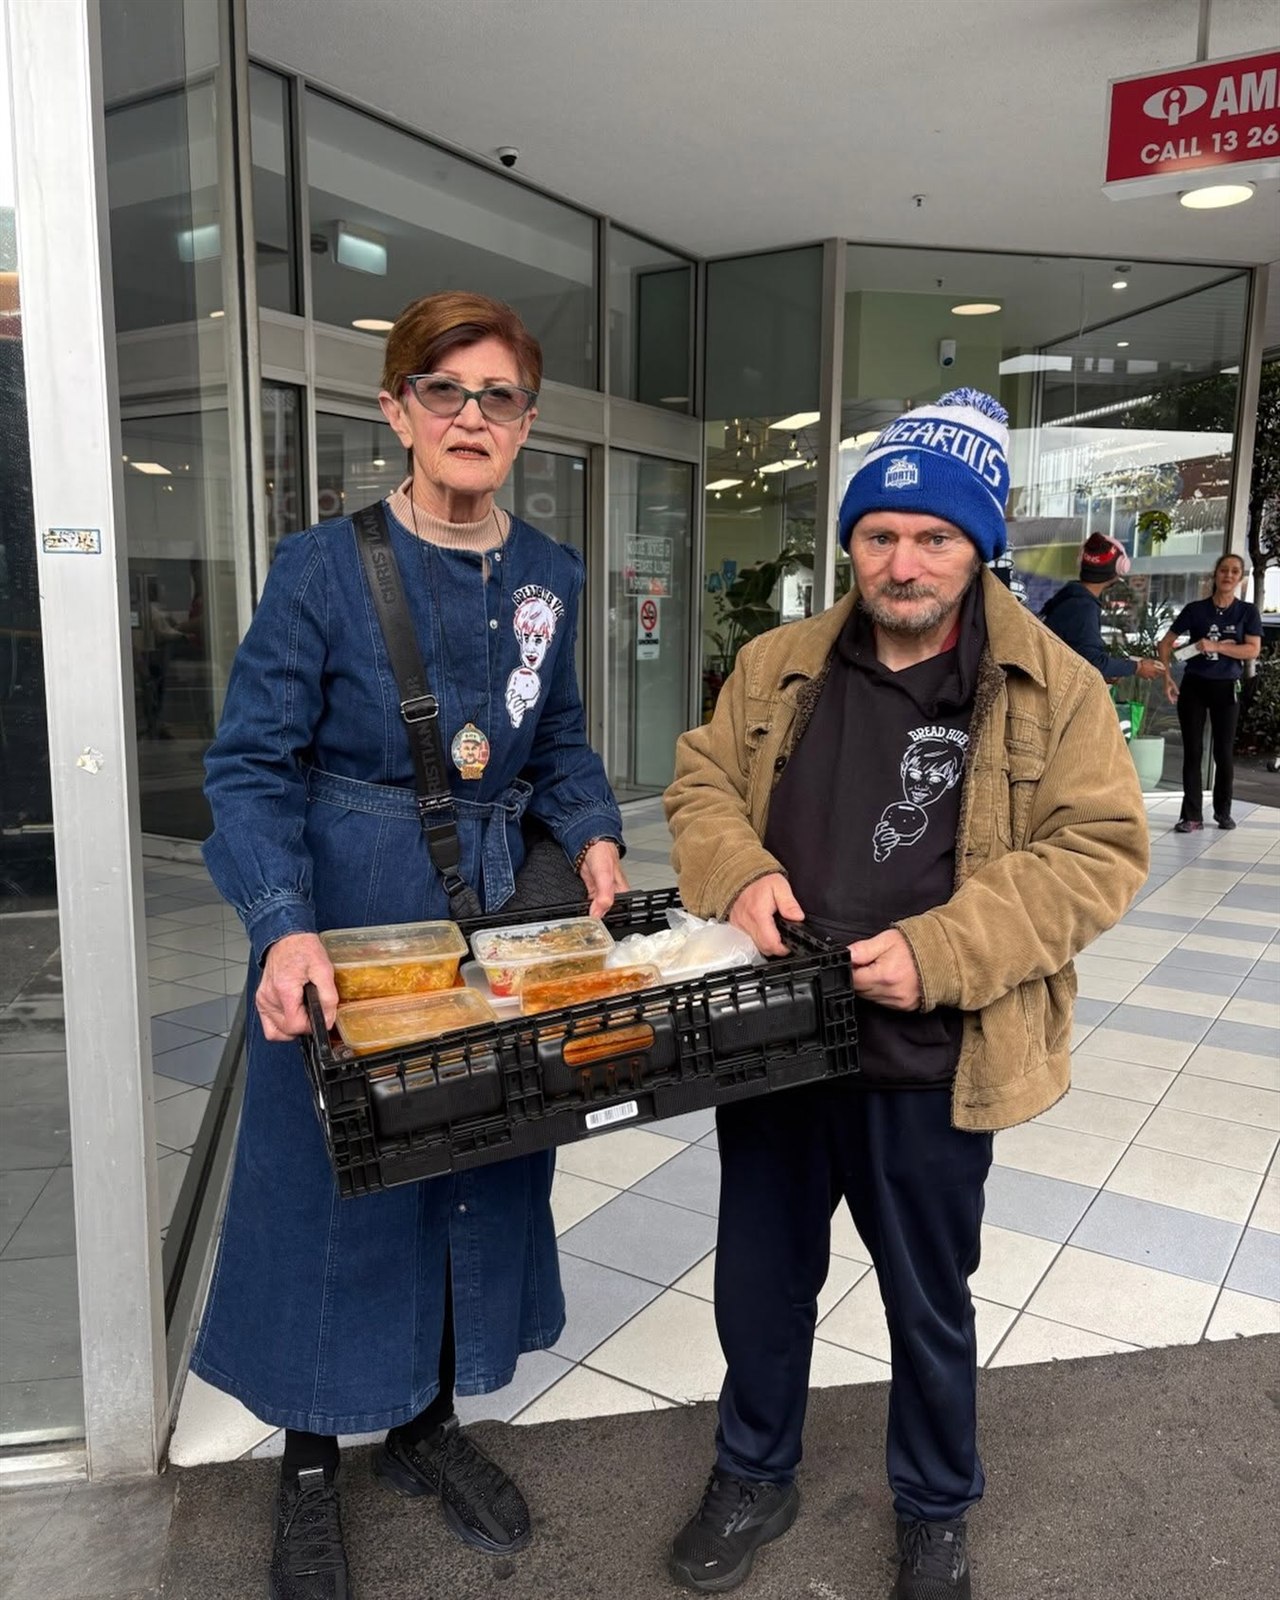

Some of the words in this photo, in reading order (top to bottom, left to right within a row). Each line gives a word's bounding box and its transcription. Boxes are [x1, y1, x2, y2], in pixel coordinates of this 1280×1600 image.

[1210, 68, 1280, 119] AM
[1140, 137, 1202, 164] CALL
[1211, 130, 1238, 153] 13
[1246, 124, 1279, 149] 26
[872, 421, 1006, 487] NGAROOS
[886, 470, 917, 483] NORTH
[362, 514, 397, 605] CHRISTIAN
[418, 723, 441, 794] RISTIAN
[907, 726, 946, 742] BREAD
[946, 728, 970, 745] HUB
